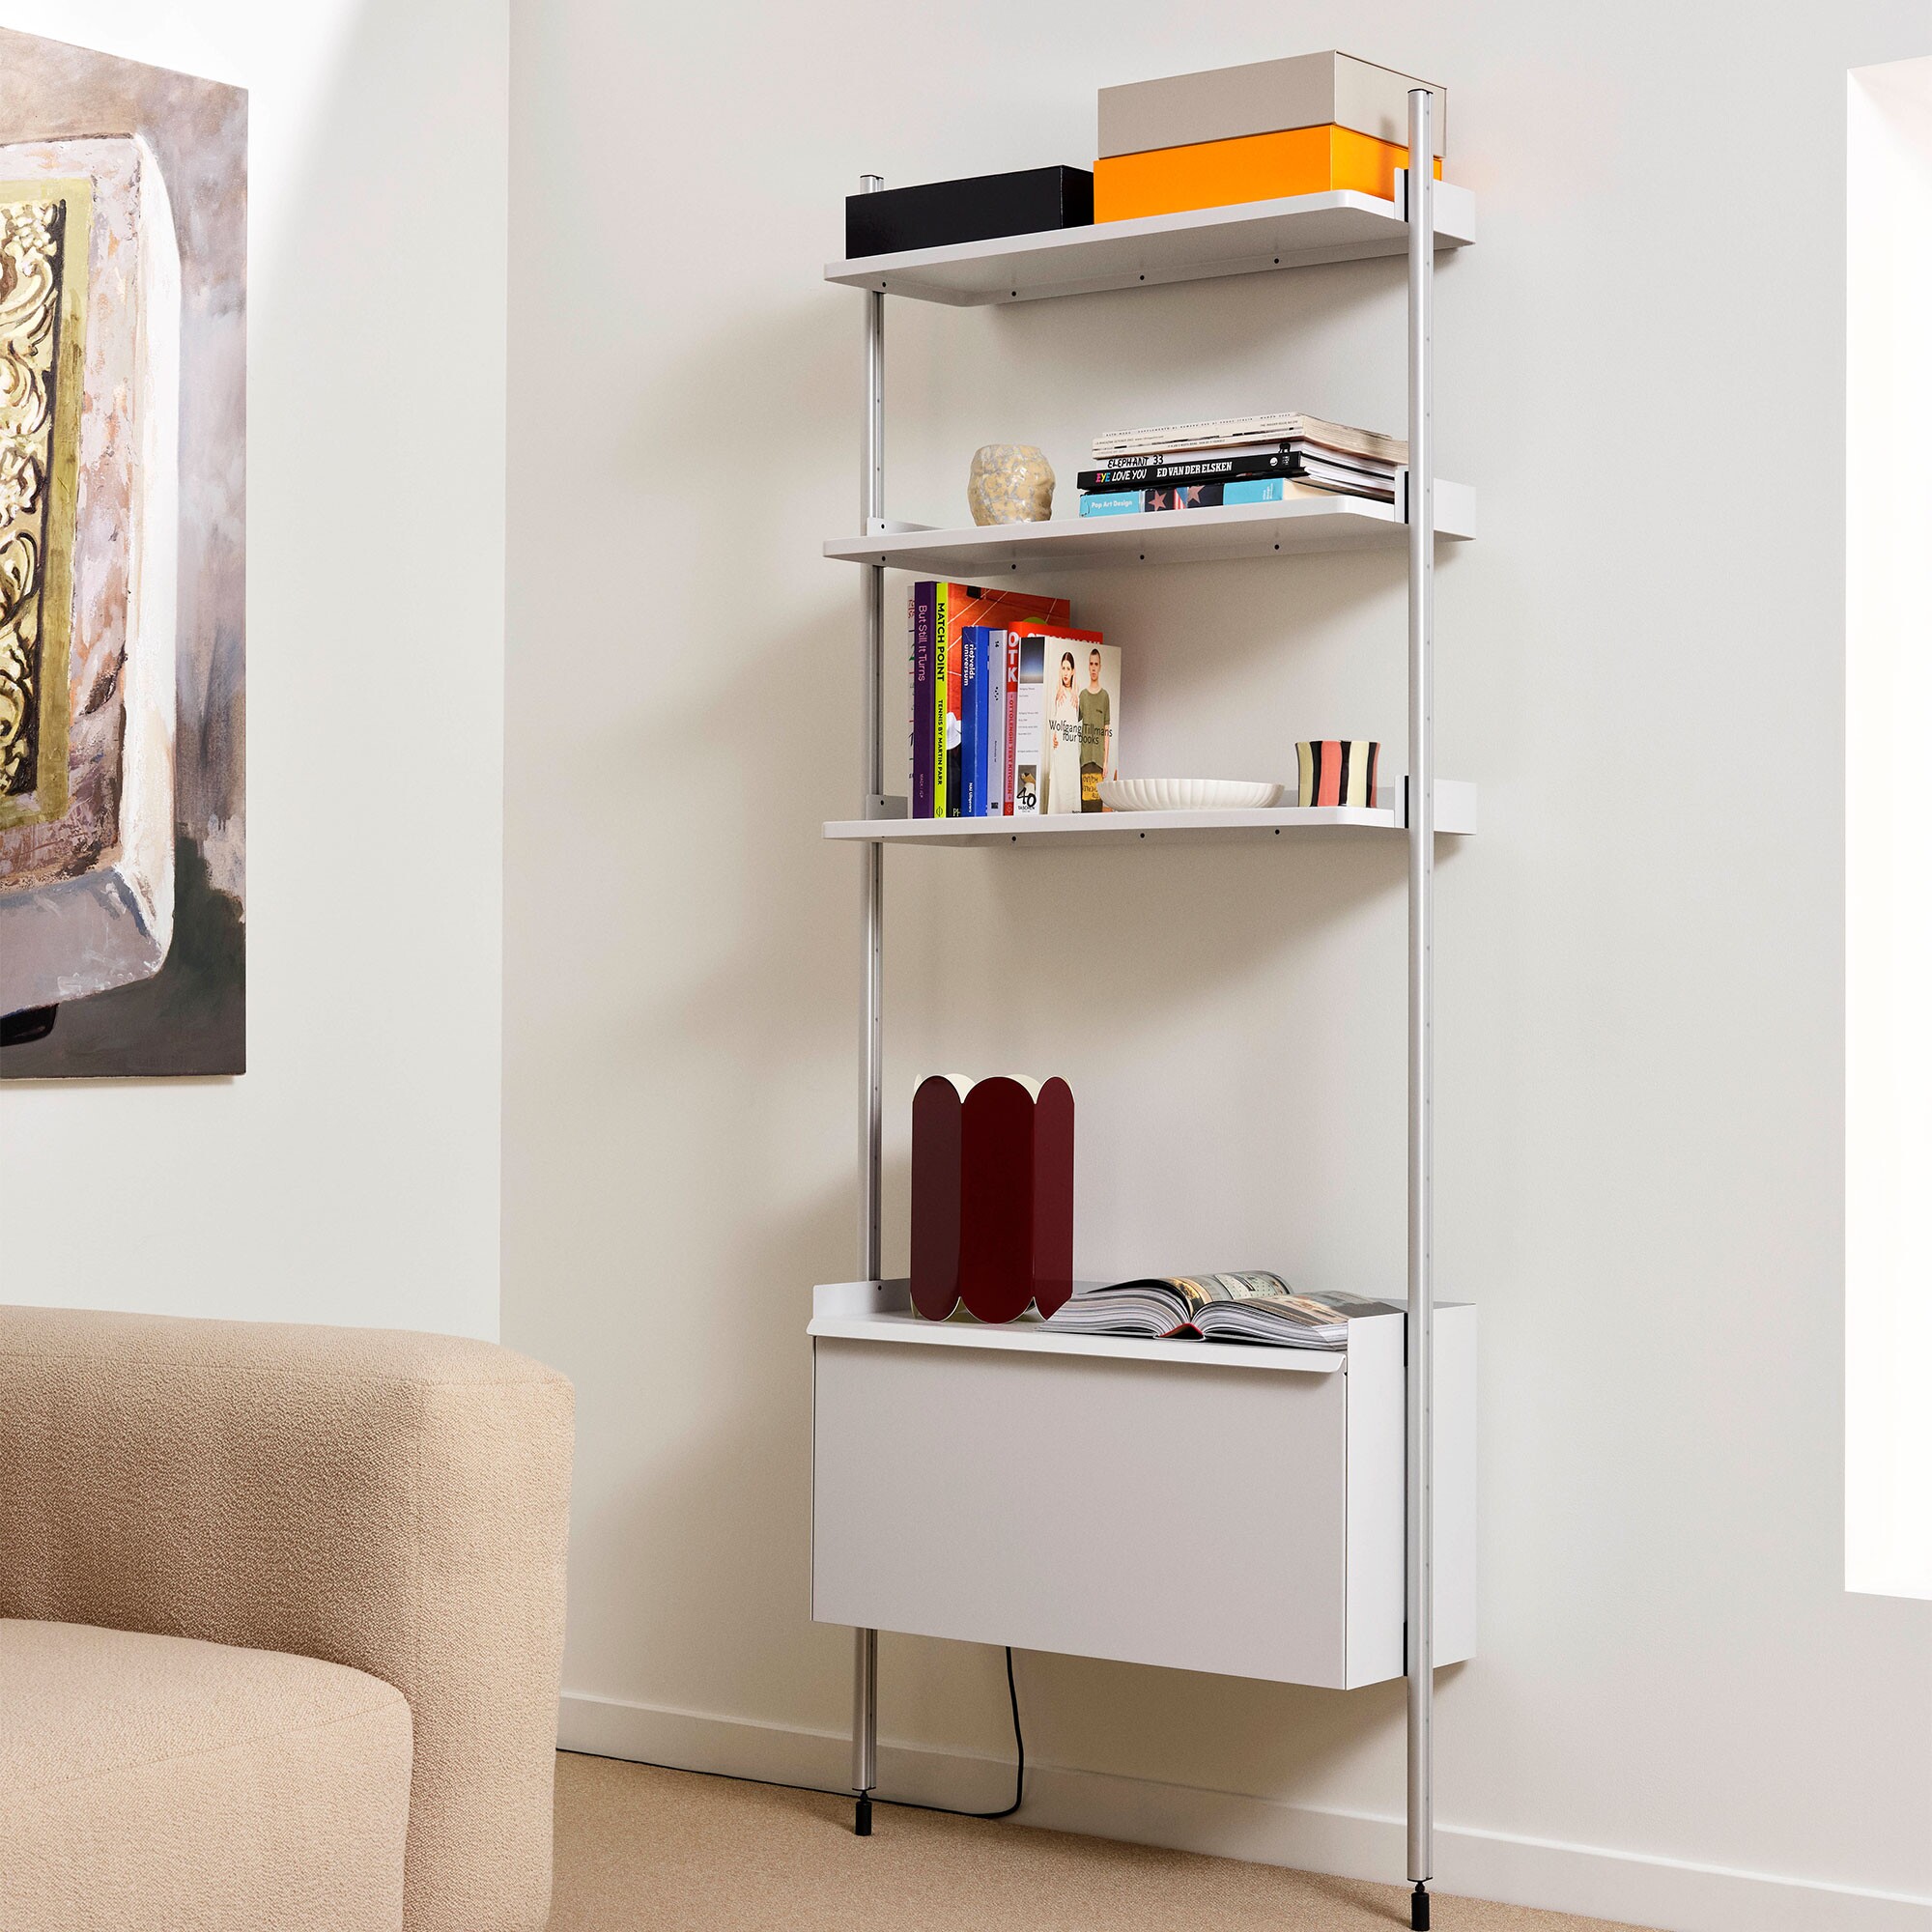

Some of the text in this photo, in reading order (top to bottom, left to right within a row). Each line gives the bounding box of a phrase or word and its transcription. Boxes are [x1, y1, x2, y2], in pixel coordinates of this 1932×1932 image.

[1107, 454, 1164, 469] ELEPHANT 33
[1095, 461, 1233, 483] EYE LOVE YOU ED VAN DER ELSKEN
[1113, 499, 1133, 508] Design
[918, 605, 927, 623] But
[936, 602, 946, 682] MATCH POINT
[1008, 631, 1019, 683] OTK
[918, 653, 927, 682] Turns
[938, 726, 943, 736] BY
[1049, 720, 1113, 737] Wolfgang Tillmans
[1063, 731, 1099, 745] four books
[1016, 786, 1037, 808] 40
